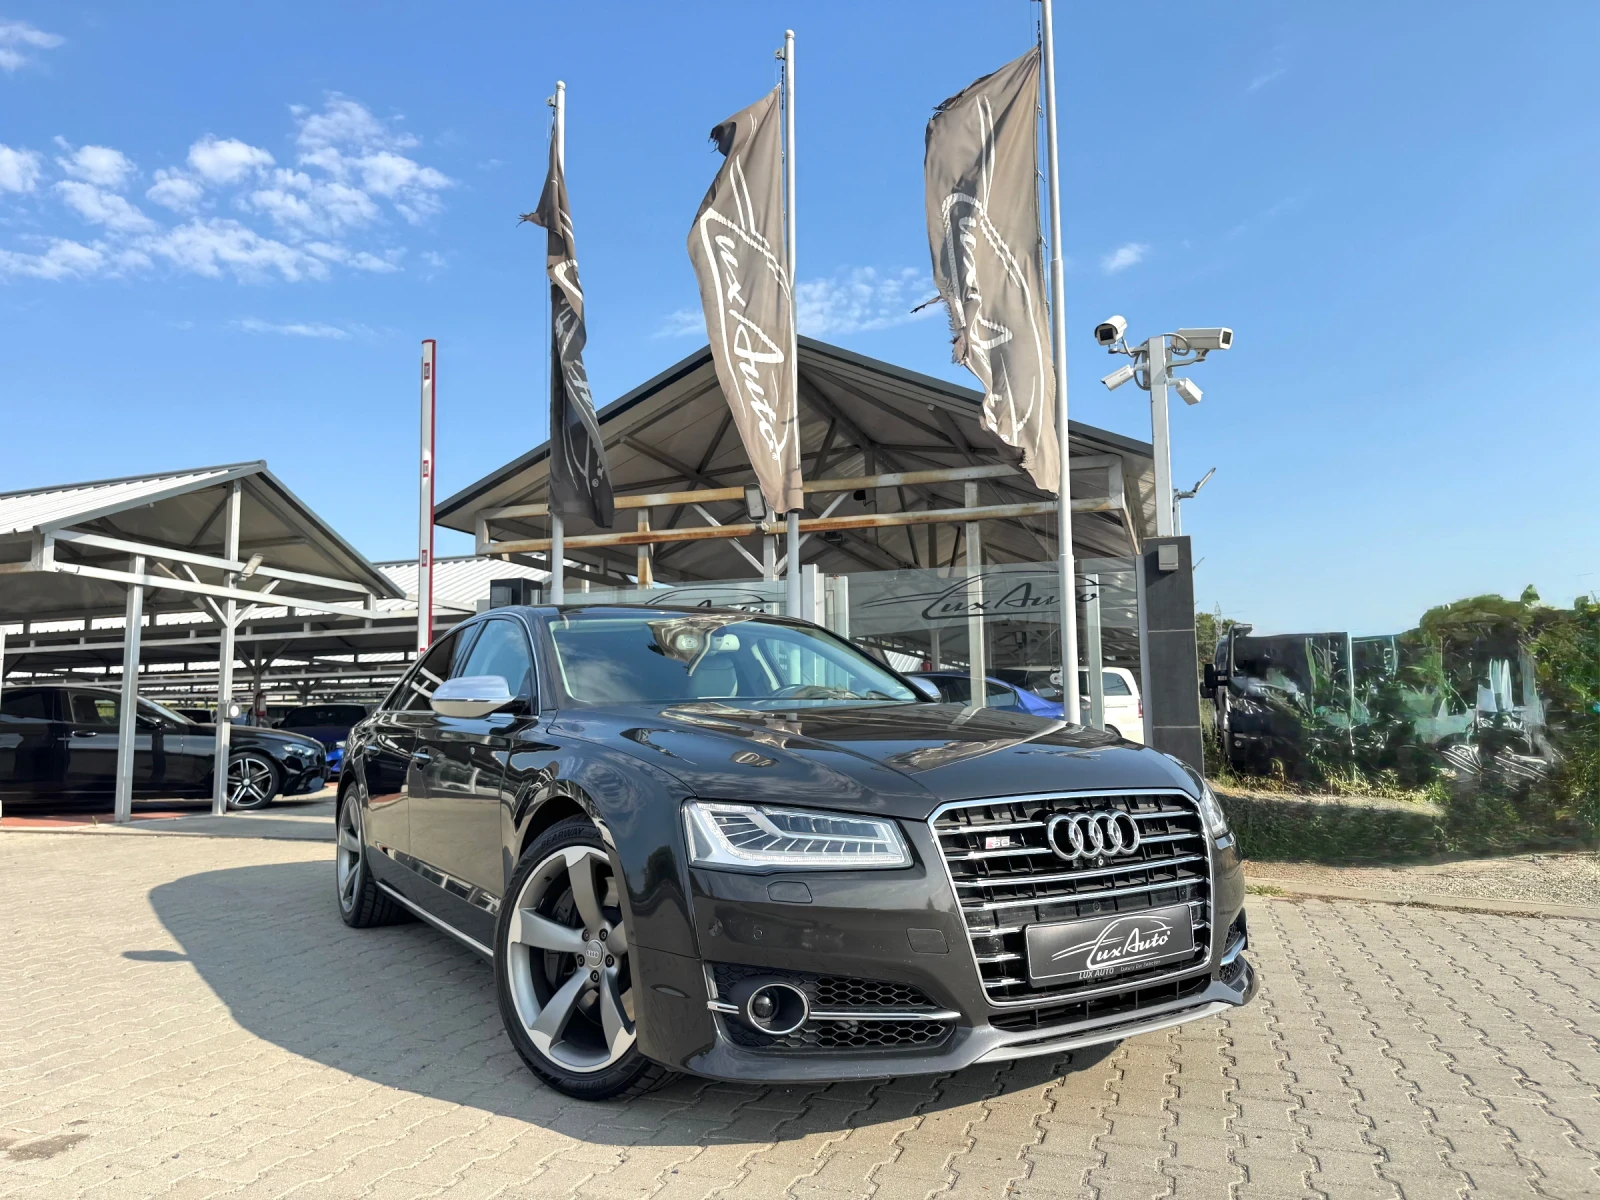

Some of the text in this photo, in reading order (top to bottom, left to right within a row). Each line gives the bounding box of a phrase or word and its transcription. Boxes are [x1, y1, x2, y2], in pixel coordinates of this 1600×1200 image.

[729, 309, 784, 450] Auto
[921, 582, 1098, 620] Lux Auo
[1086, 927, 1169, 969] Lux Auto
[1079, 970, 1093, 980] LUX
[1095, 968, 1114, 977] AUTO
